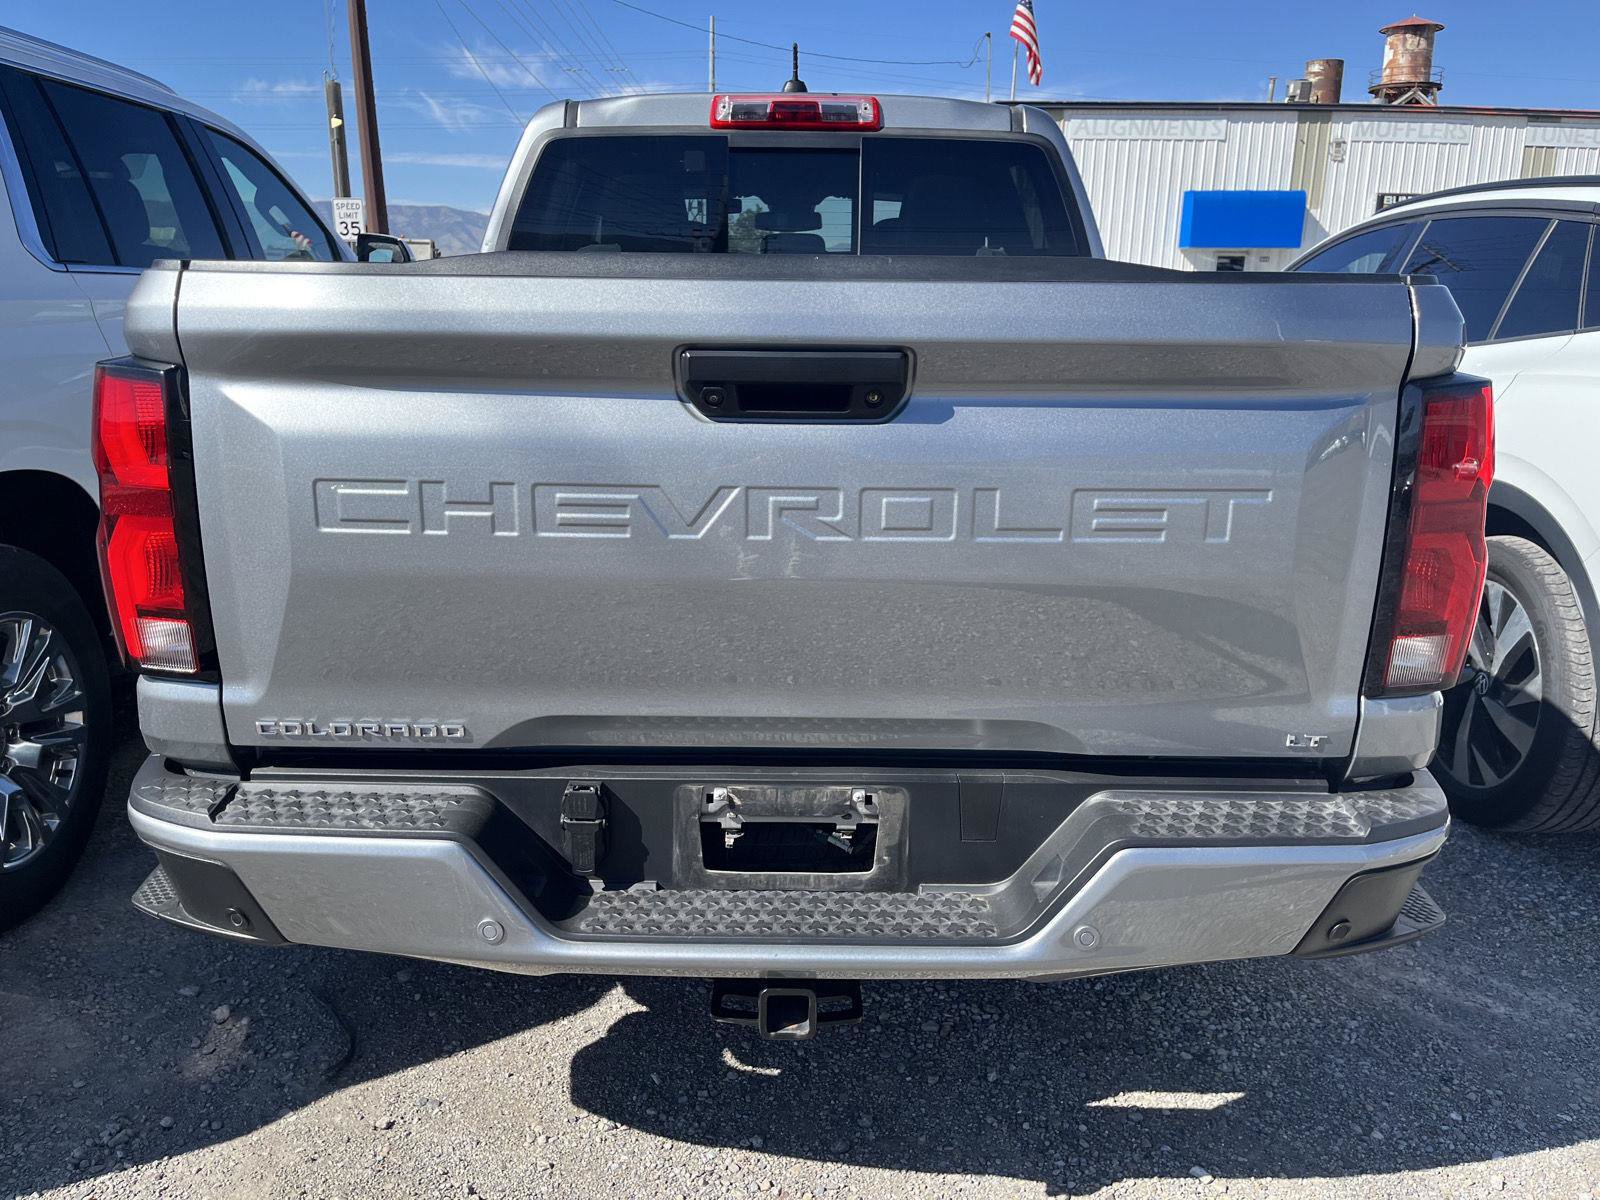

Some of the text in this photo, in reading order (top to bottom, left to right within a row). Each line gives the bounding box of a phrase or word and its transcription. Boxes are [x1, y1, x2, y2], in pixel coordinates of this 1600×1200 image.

[1073, 119, 1222, 137] ALIGNMENTS
[1354, 122, 1468, 140] MUFFLERS
[335, 202, 361, 210] SPEED
[338, 211, 359, 220] LIMIT
[339, 221, 361, 236] 35
[312, 477, 1274, 544] CHEVROLET
[255, 719, 466, 739] COLORADO
[1285, 733, 1329, 748] LT
